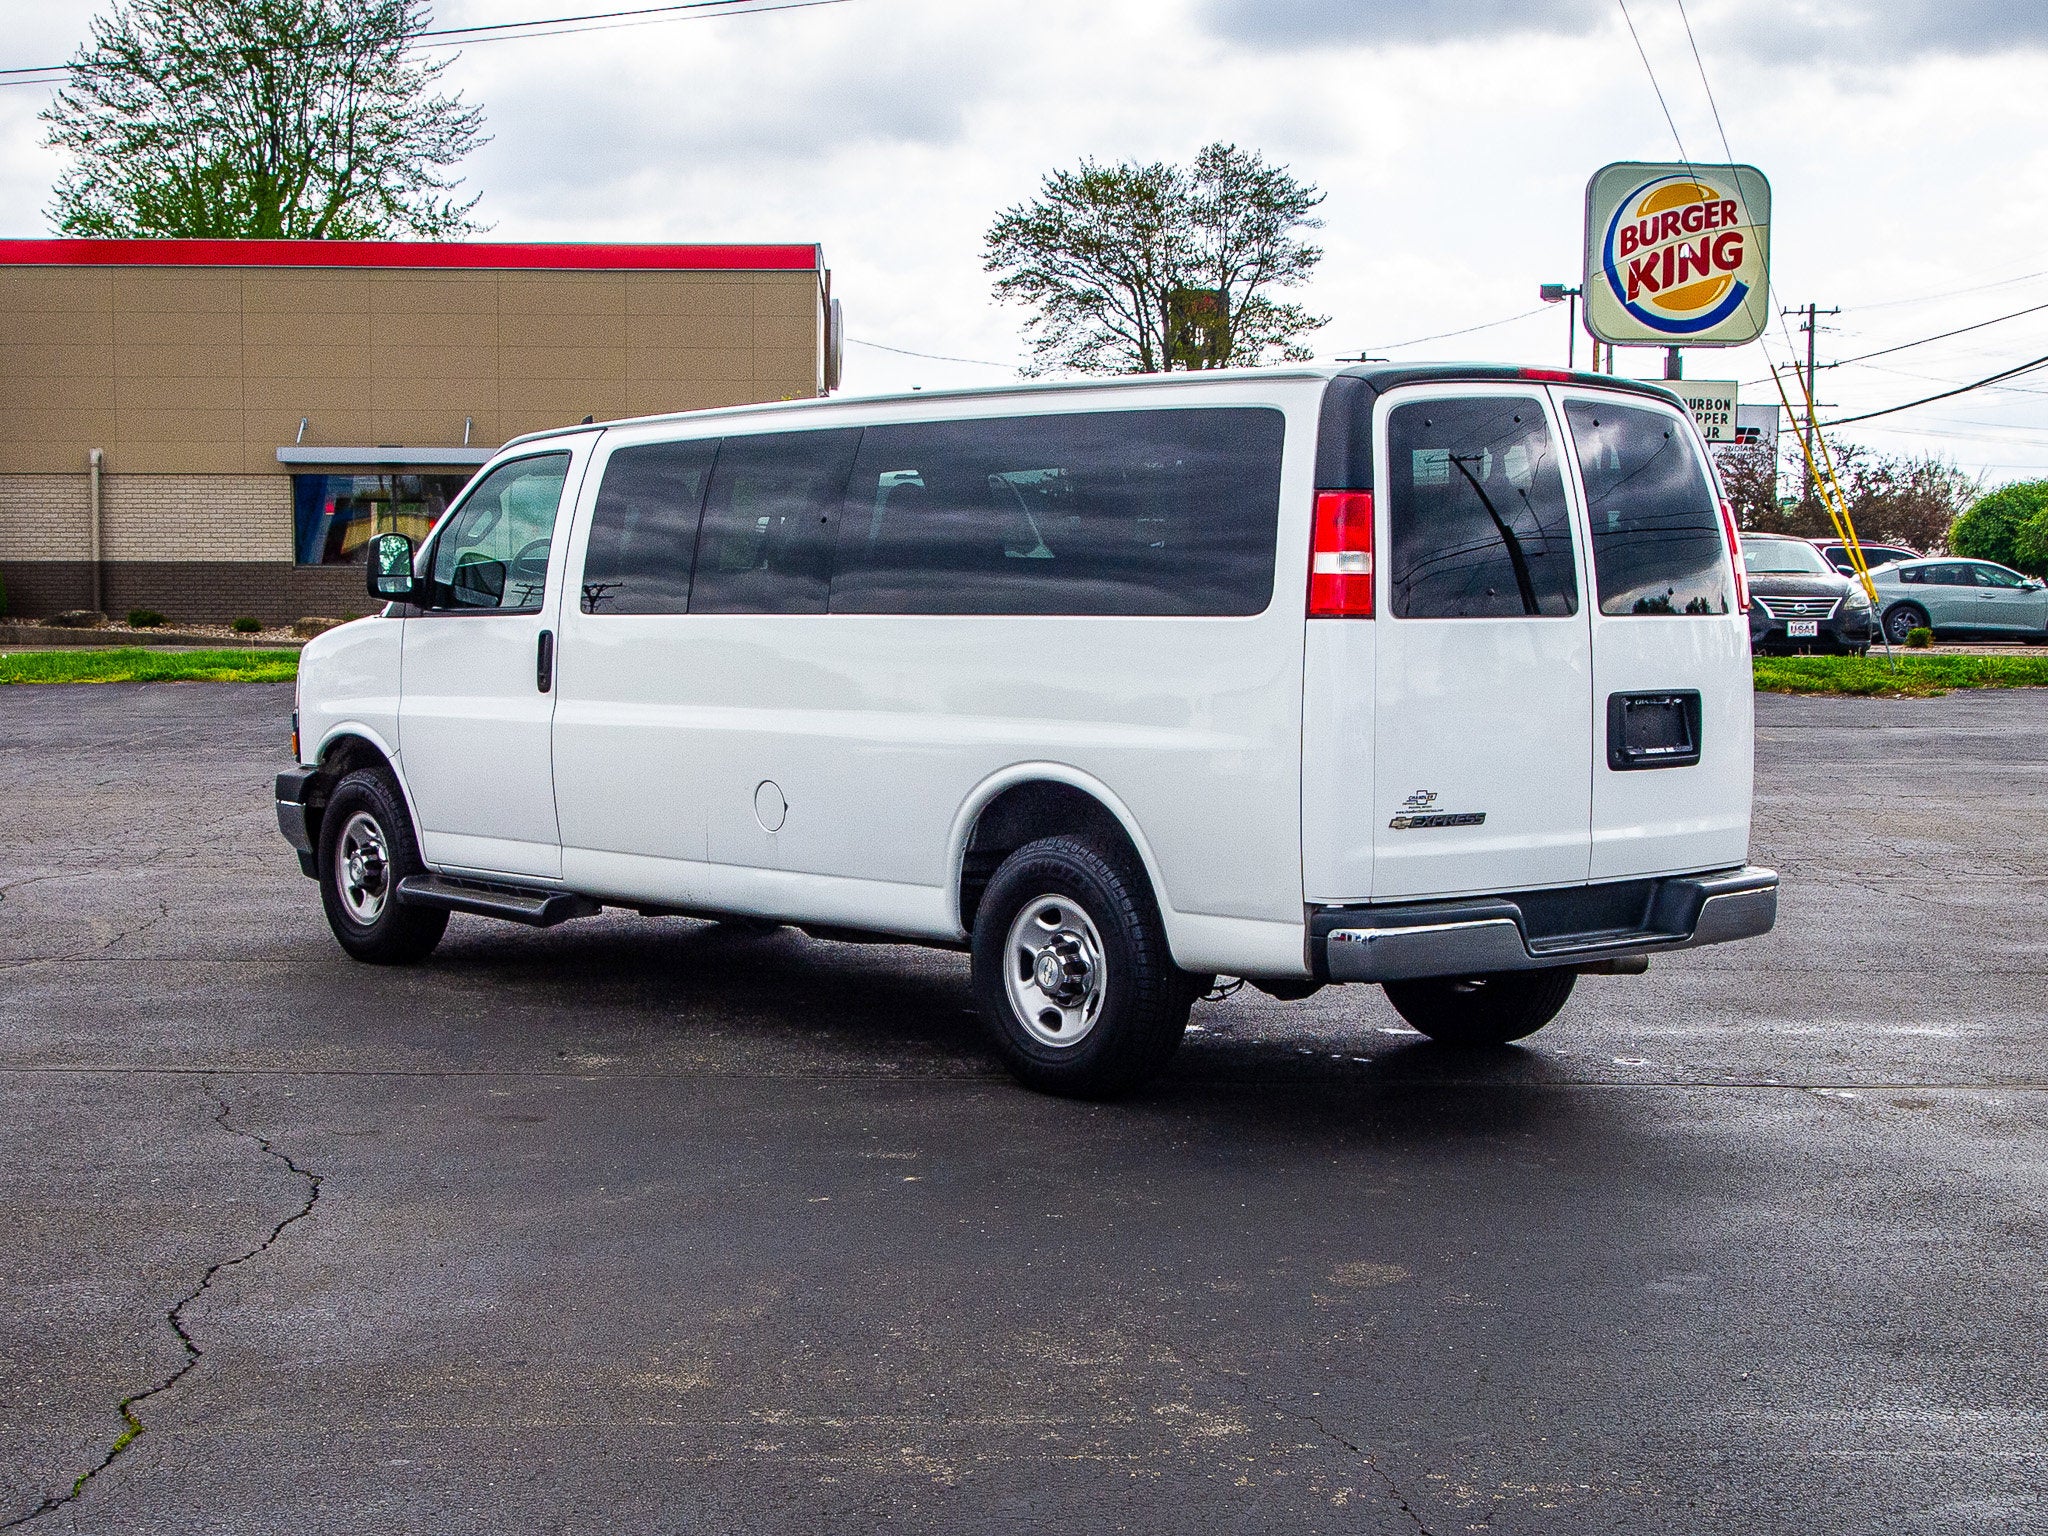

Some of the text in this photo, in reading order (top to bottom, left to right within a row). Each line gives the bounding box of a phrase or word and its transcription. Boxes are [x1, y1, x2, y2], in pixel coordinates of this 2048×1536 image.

[1620, 199, 1738, 258] BURGER
[1627, 231, 1744, 302] KING
[1683, 398, 1731, 411] URBON
[1703, 426, 1720, 439] JR
[1410, 813, 1485, 828] EXPRESS
